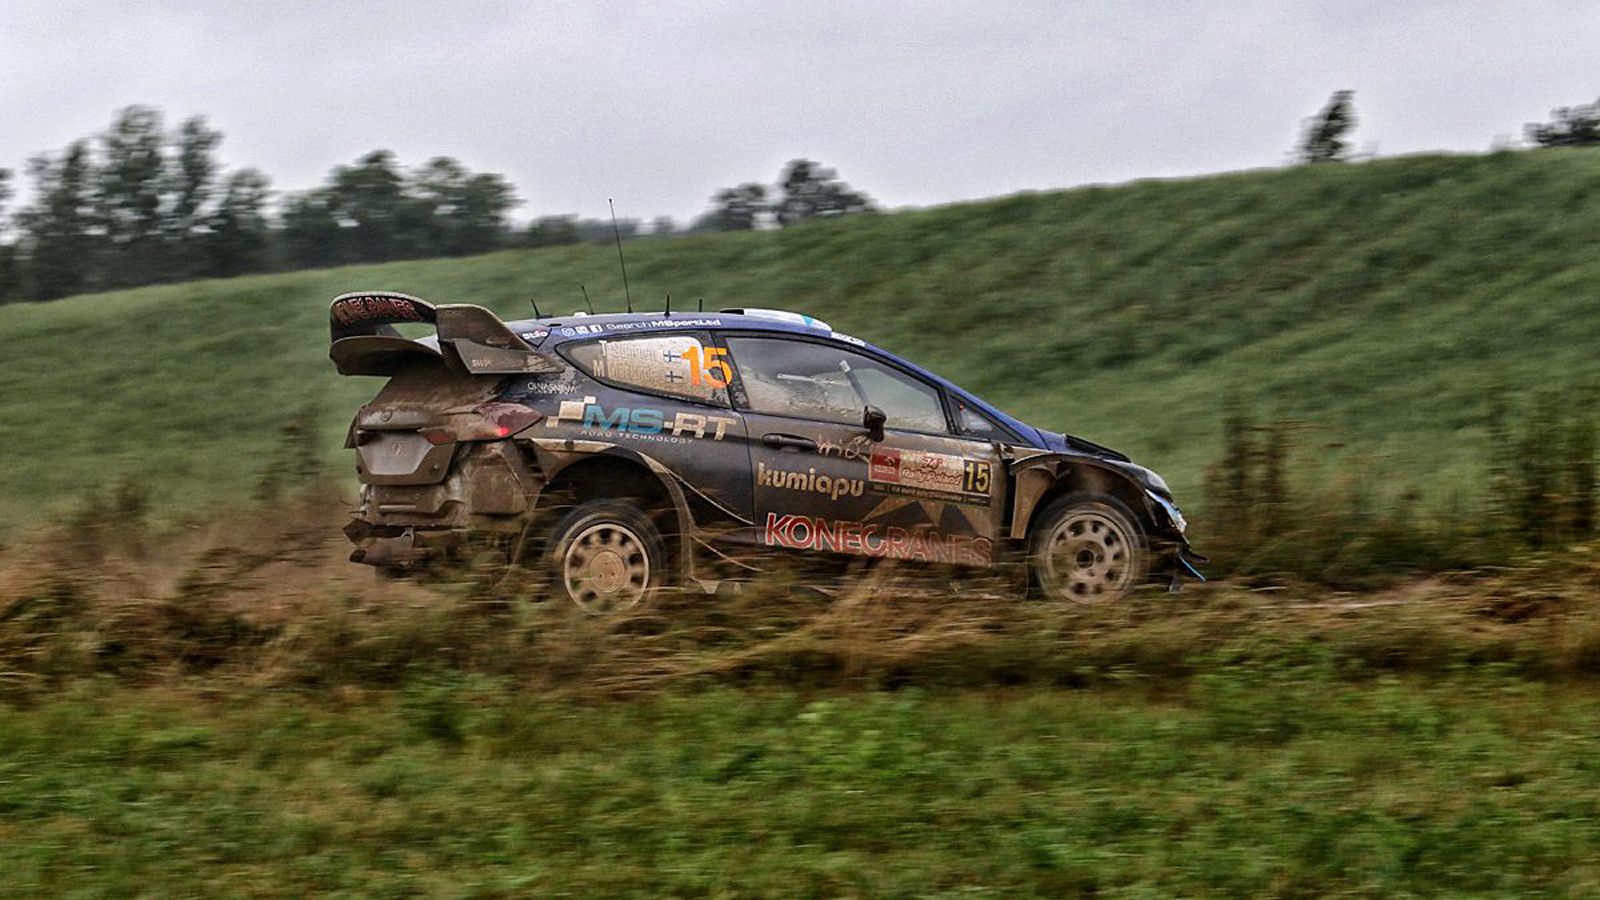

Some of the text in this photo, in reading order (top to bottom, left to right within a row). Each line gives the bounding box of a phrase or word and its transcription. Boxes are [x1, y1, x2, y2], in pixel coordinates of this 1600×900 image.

[681, 345, 733, 389] 15
[582, 405, 737, 441] MS-RT
[619, 433, 694, 444] TECHNOLOGY
[757, 462, 864, 500] kumiapu
[902, 467, 926, 483] Rally
[926, 470, 963, 486] Poland
[965, 462, 990, 493] 15
[765, 512, 993, 568] KONECRANES
